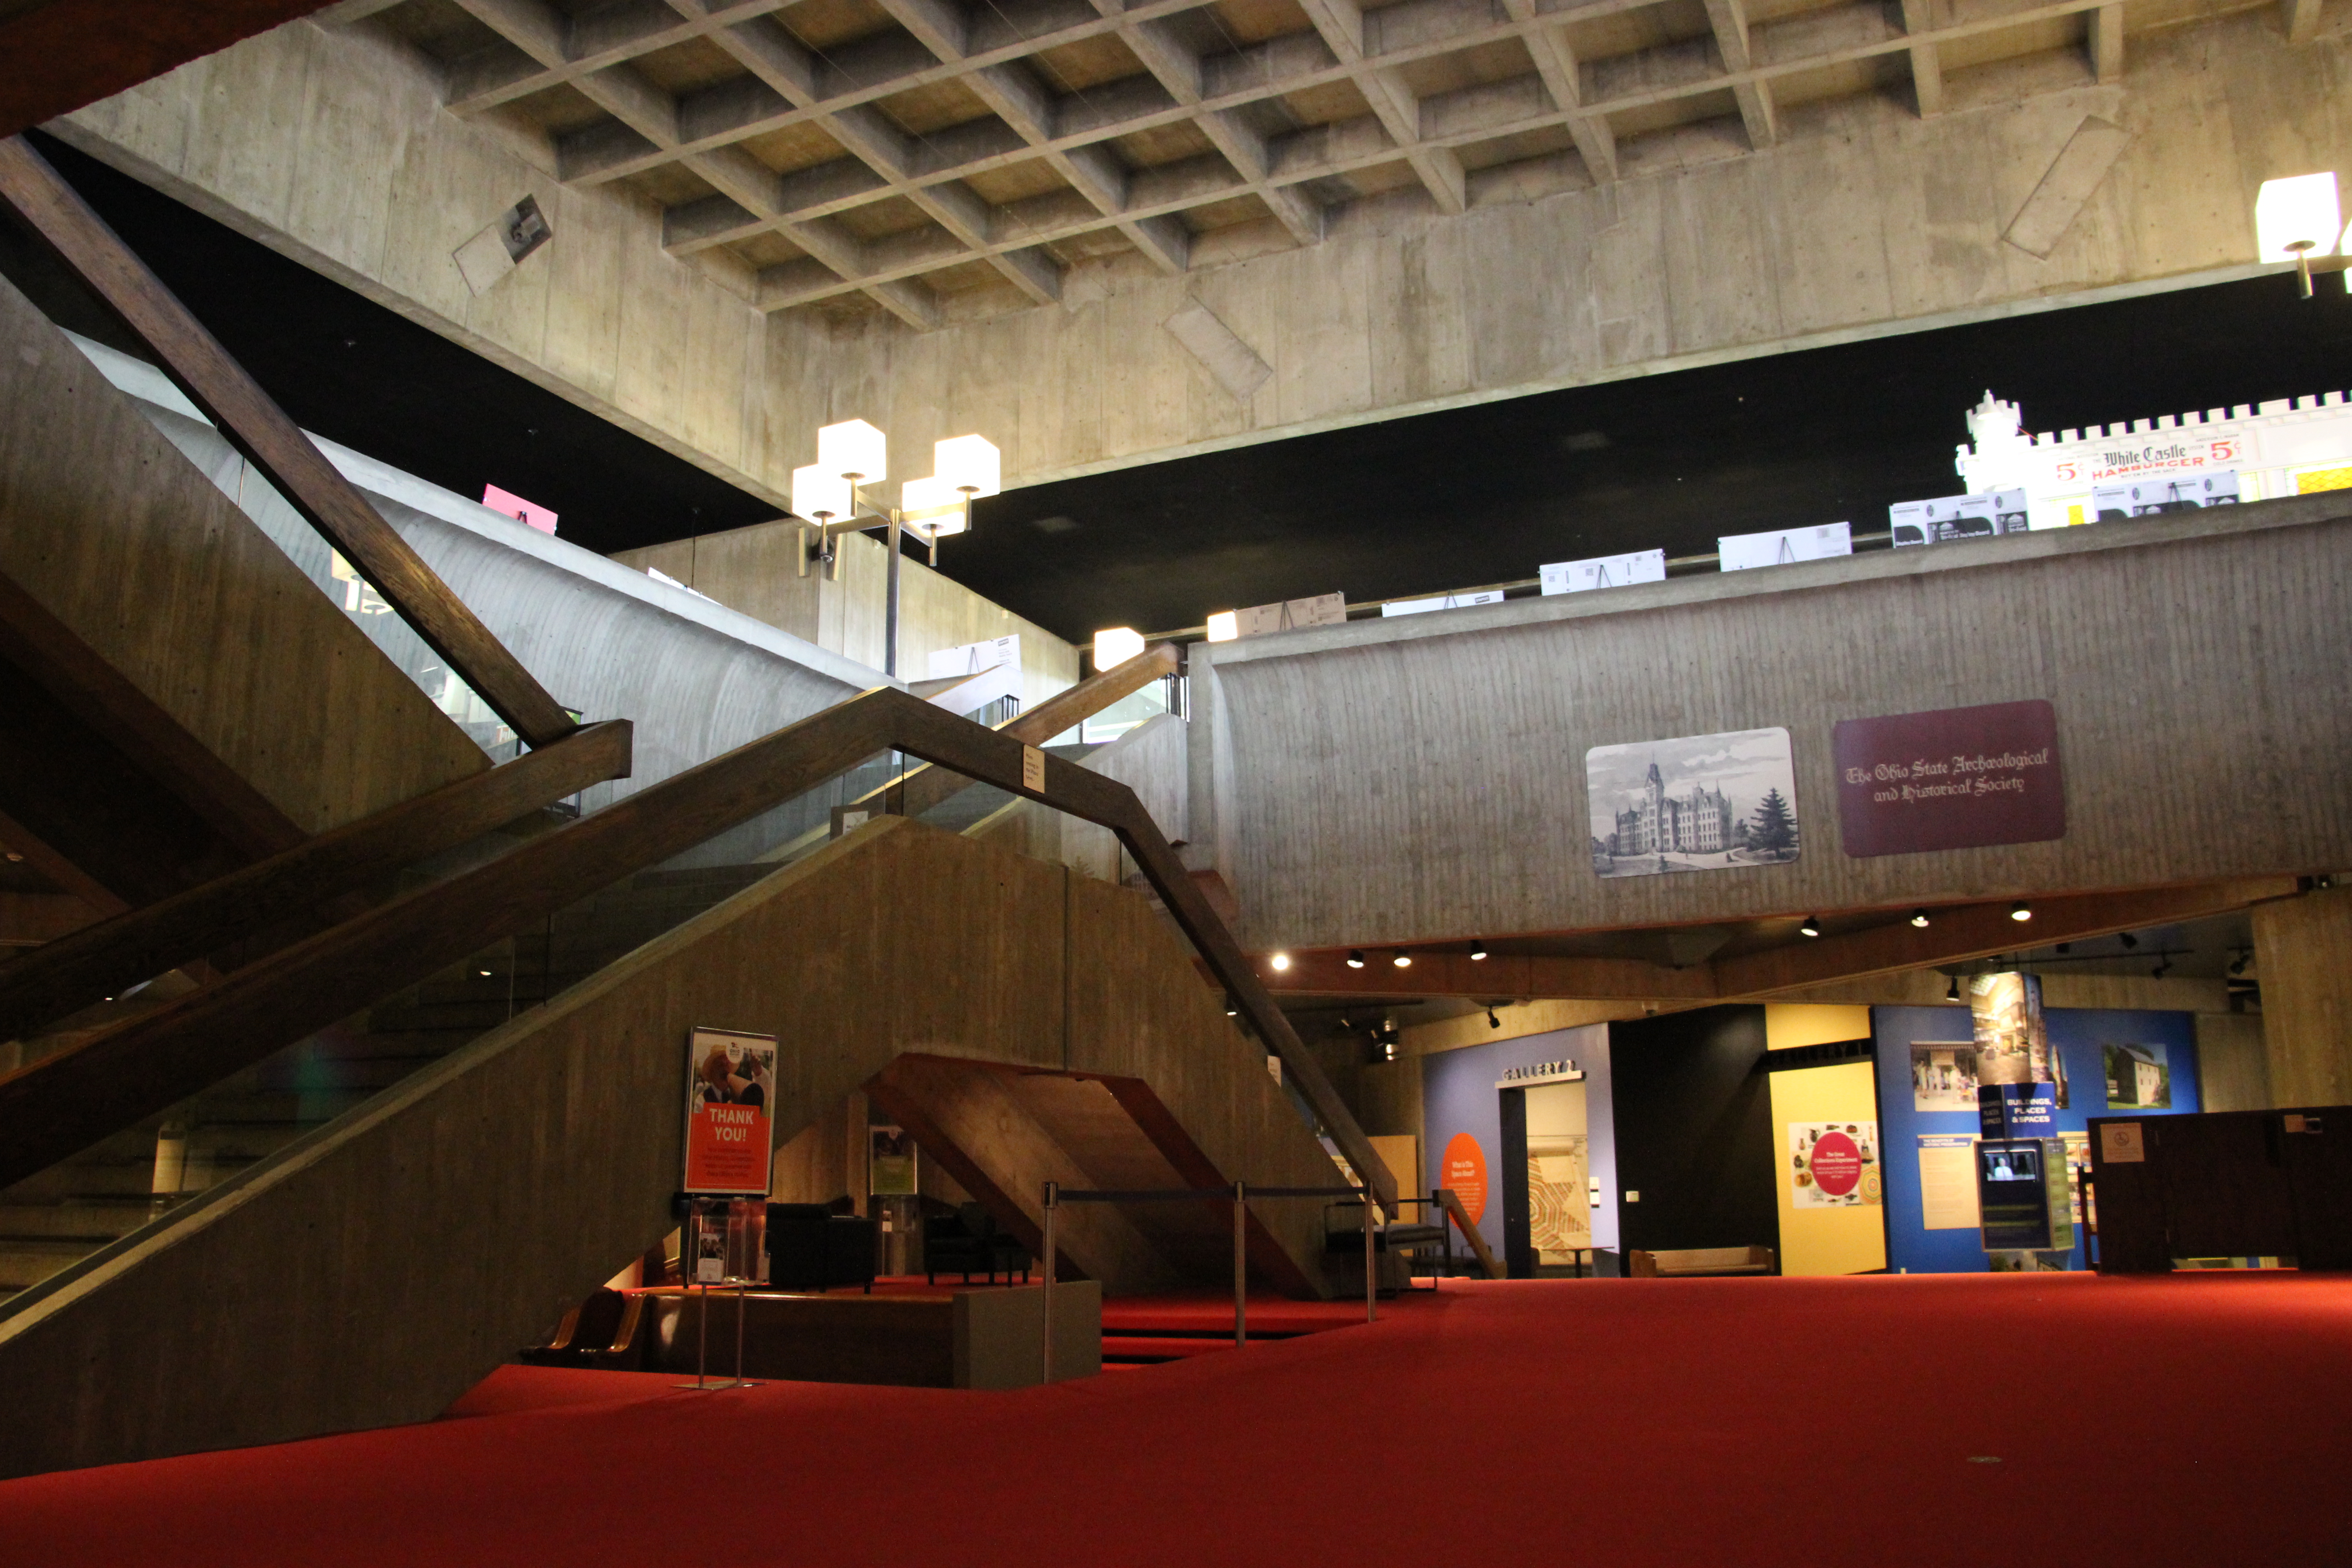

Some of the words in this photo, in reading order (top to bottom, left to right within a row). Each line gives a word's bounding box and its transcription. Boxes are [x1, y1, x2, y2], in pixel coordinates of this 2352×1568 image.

[2103, 451, 2140, 467] White
[2143, 444, 2186, 462] Castle
[2092, 457, 2205, 480] HAMBURGER
[1846, 767, 1872, 785] The
[1875, 764, 1909, 783] Ohio
[1911, 759, 1948, 780] State
[1874, 787, 1898, 802] and
[1902, 779, 1971, 804] Historical
[1975, 776, 2025, 796] Society
[1502, 1061, 1560, 1080] GALLERY
[709, 1108, 754, 1125] THANK
[715, 1127, 747, 1142] YOU!
